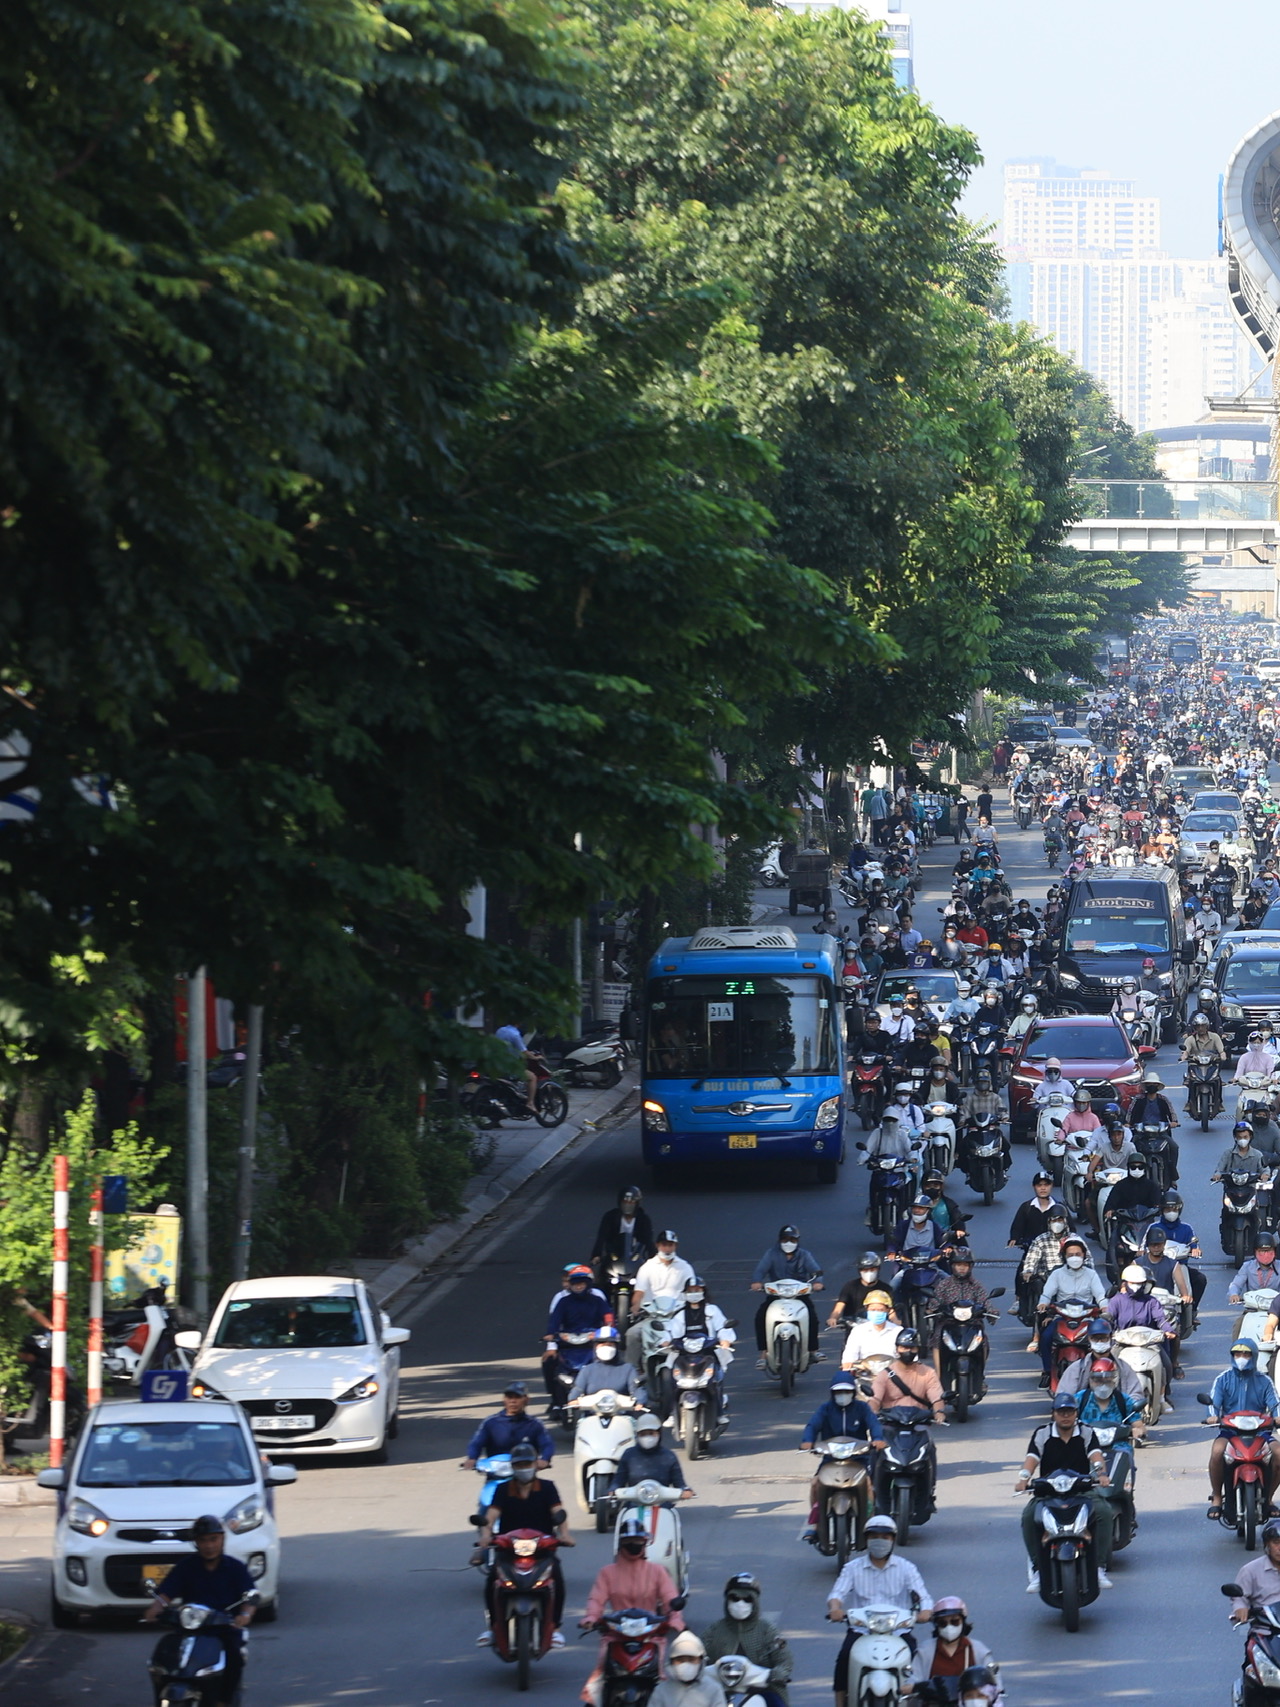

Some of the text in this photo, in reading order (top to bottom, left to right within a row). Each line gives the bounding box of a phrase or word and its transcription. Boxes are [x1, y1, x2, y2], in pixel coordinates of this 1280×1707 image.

[1084, 899, 1154, 908] LIMOUSINE
[914, 956, 926, 967] G7
[710, 1006, 732, 1017] 21A
[703, 1081, 724, 1092] BUS
[151, 1375, 178, 1399] G7
